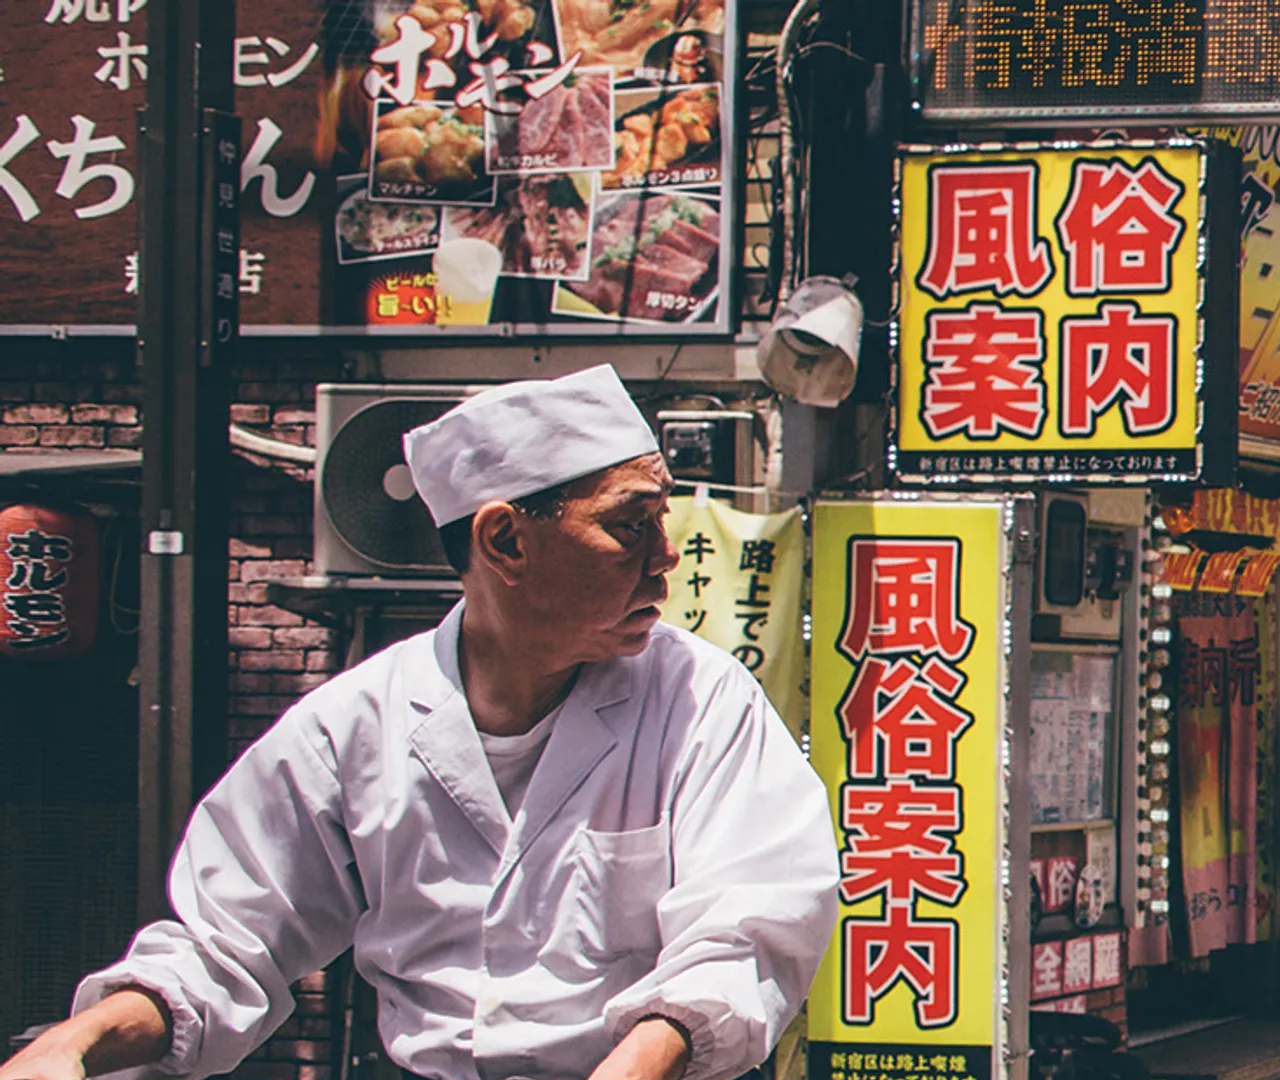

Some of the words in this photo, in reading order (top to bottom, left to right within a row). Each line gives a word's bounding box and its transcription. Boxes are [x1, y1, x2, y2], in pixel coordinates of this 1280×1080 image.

[94, 31, 320, 90] ホモン
[364, 12, 582, 115] ホルモン
[920, 158, 1186, 298] 風俗
[920, 302, 1182, 441] 案内
[4, 528, 74, 651] ホルモン
[834, 534, 976, 1030] 風俗案内
[830, 1052, 967, 1073] 新宿区は路上喫煙
